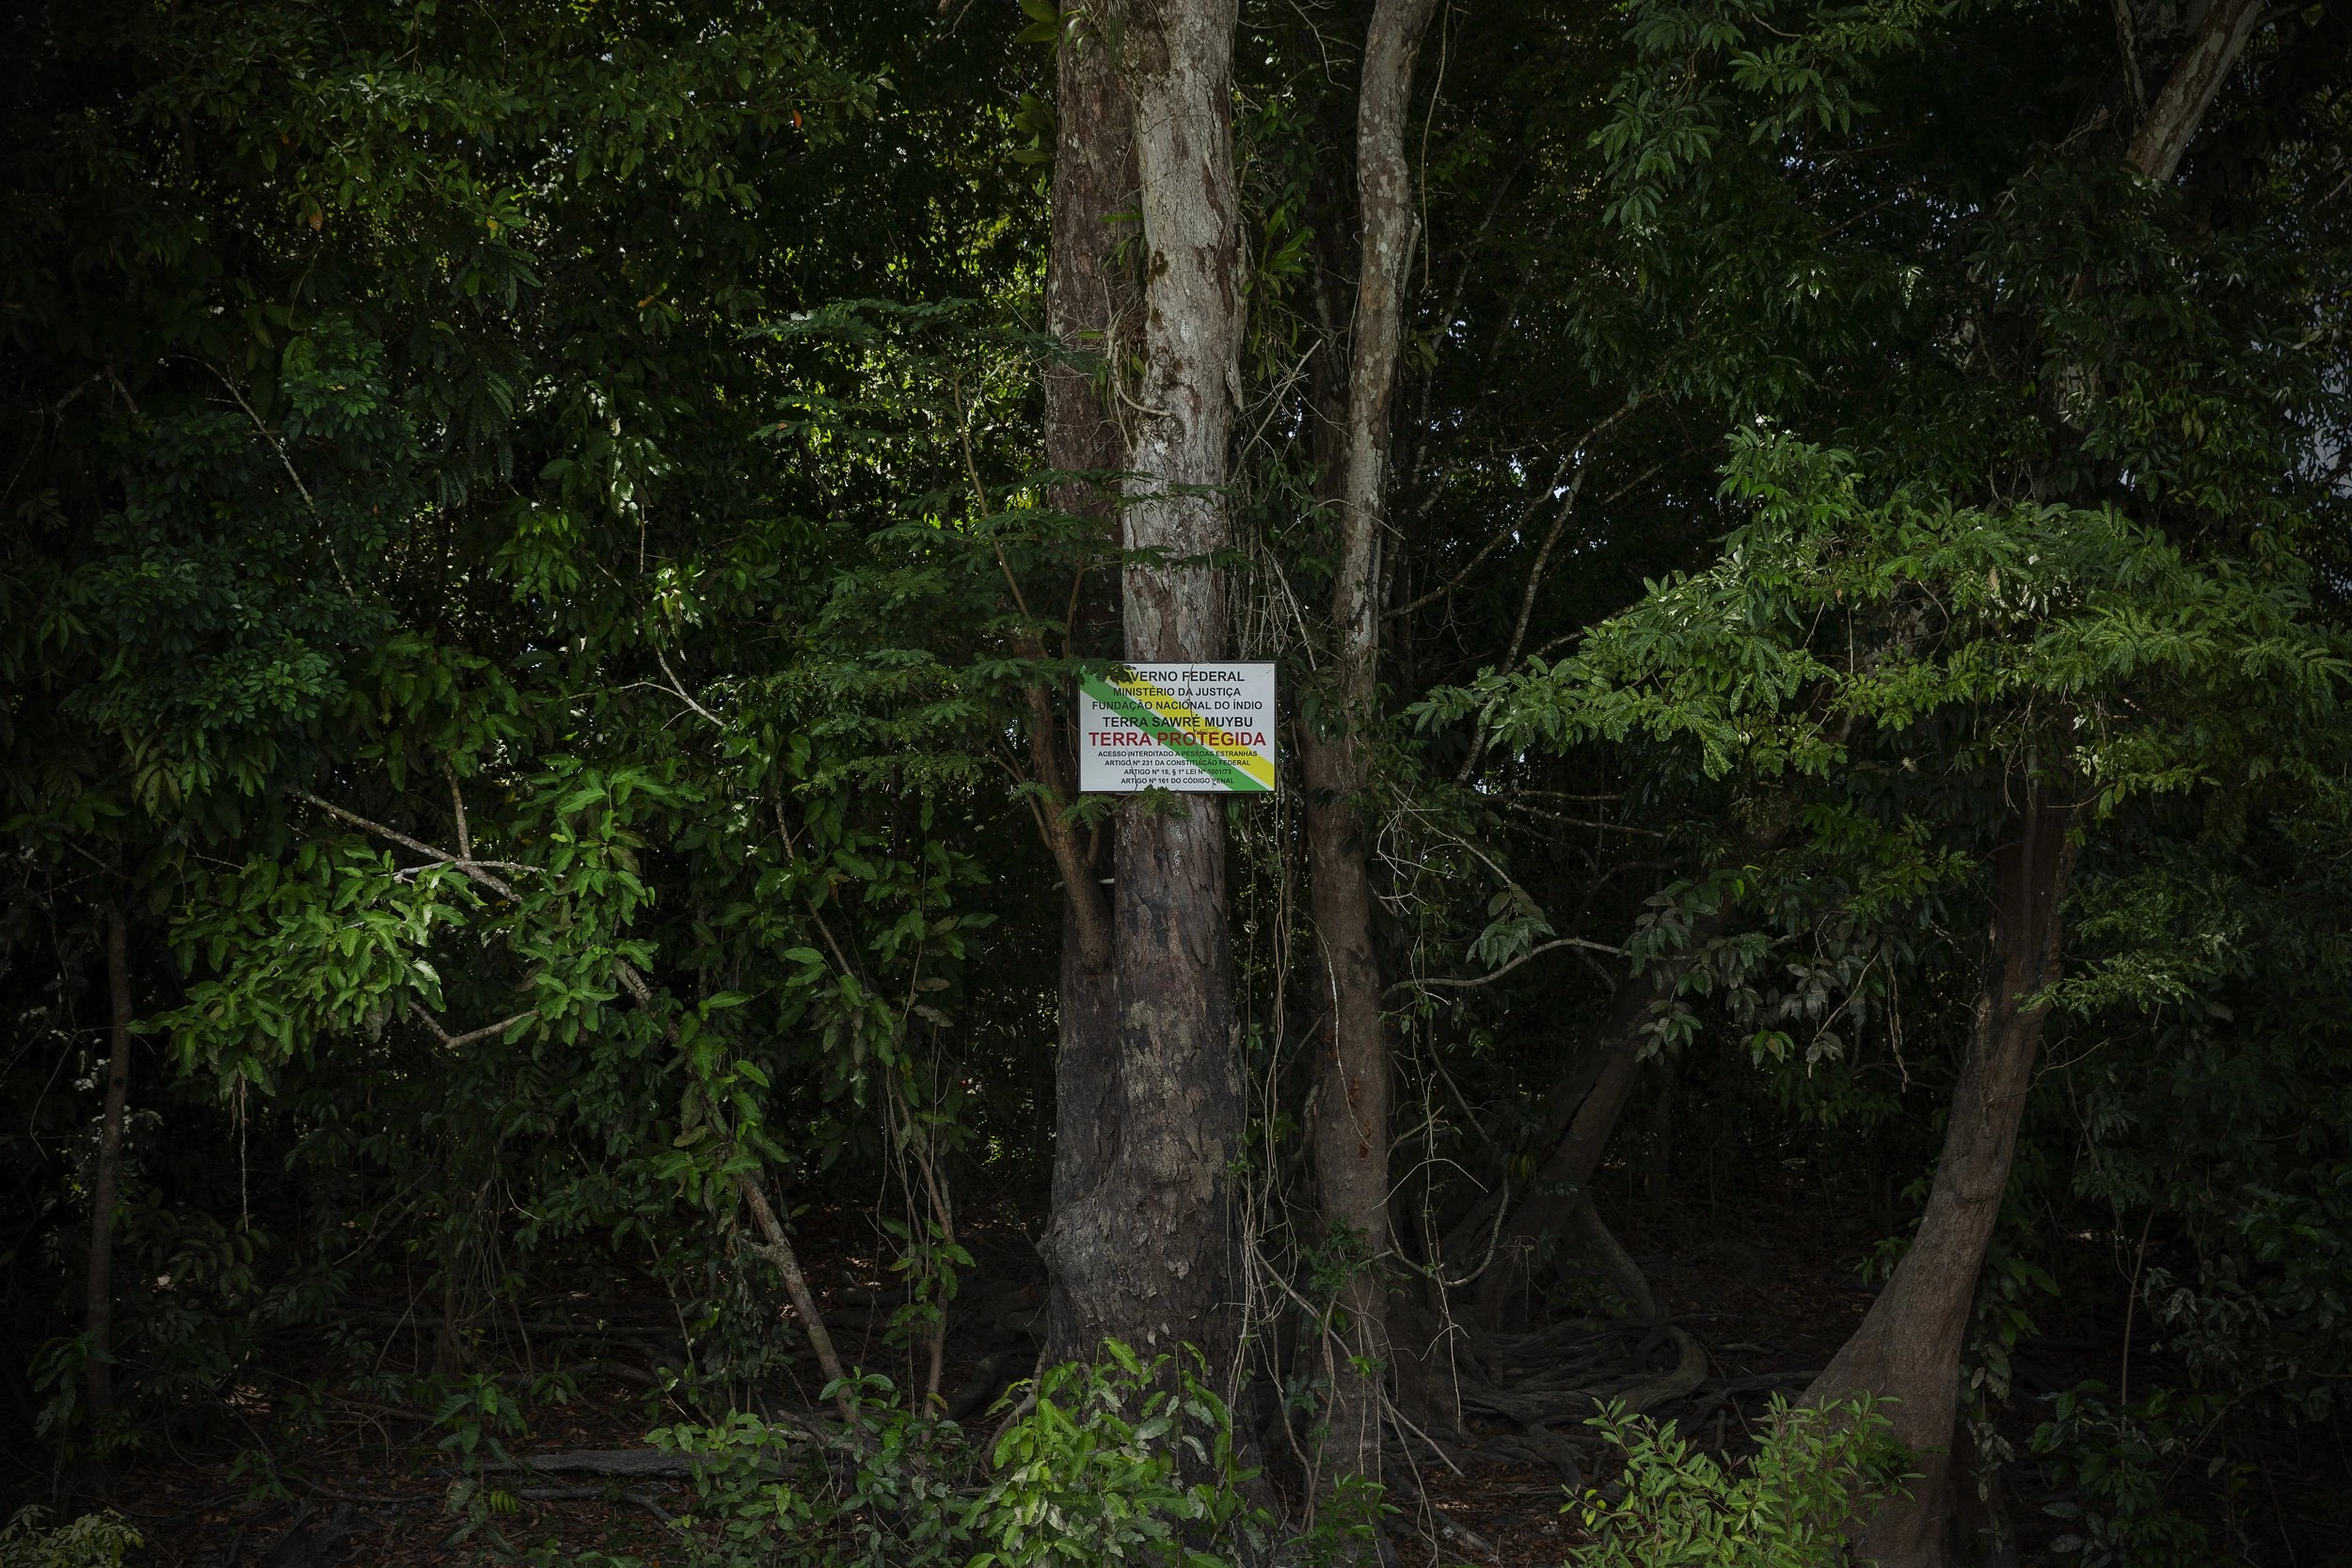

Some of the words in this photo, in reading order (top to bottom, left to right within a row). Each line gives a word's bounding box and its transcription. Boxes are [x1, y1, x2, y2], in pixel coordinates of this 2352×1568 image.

[1133, 671, 1177, 681] VERNO
[1183, 671, 1245, 681] FEDERAL
[1113, 686, 1175, 696] MINISTÉRIO
[1178, 688, 1193, 696] DA
[1196, 688, 1241, 698] JUSTIÇA
[1092, 700, 1152, 711] FUNDAÇÃO
[1233, 699, 1263, 709] ÍNDIO
[1103, 717, 1148, 727] TERRA
[1152, 714, 1200, 727] SAWRÉ
[1205, 717, 1252, 727] MUYBU
[1089, 732, 1152, 746] TERRA
[1157, 732, 1266, 746] PROTEGIDA
[1167, 758, 1216, 767] CONSTITUIÇÃO
